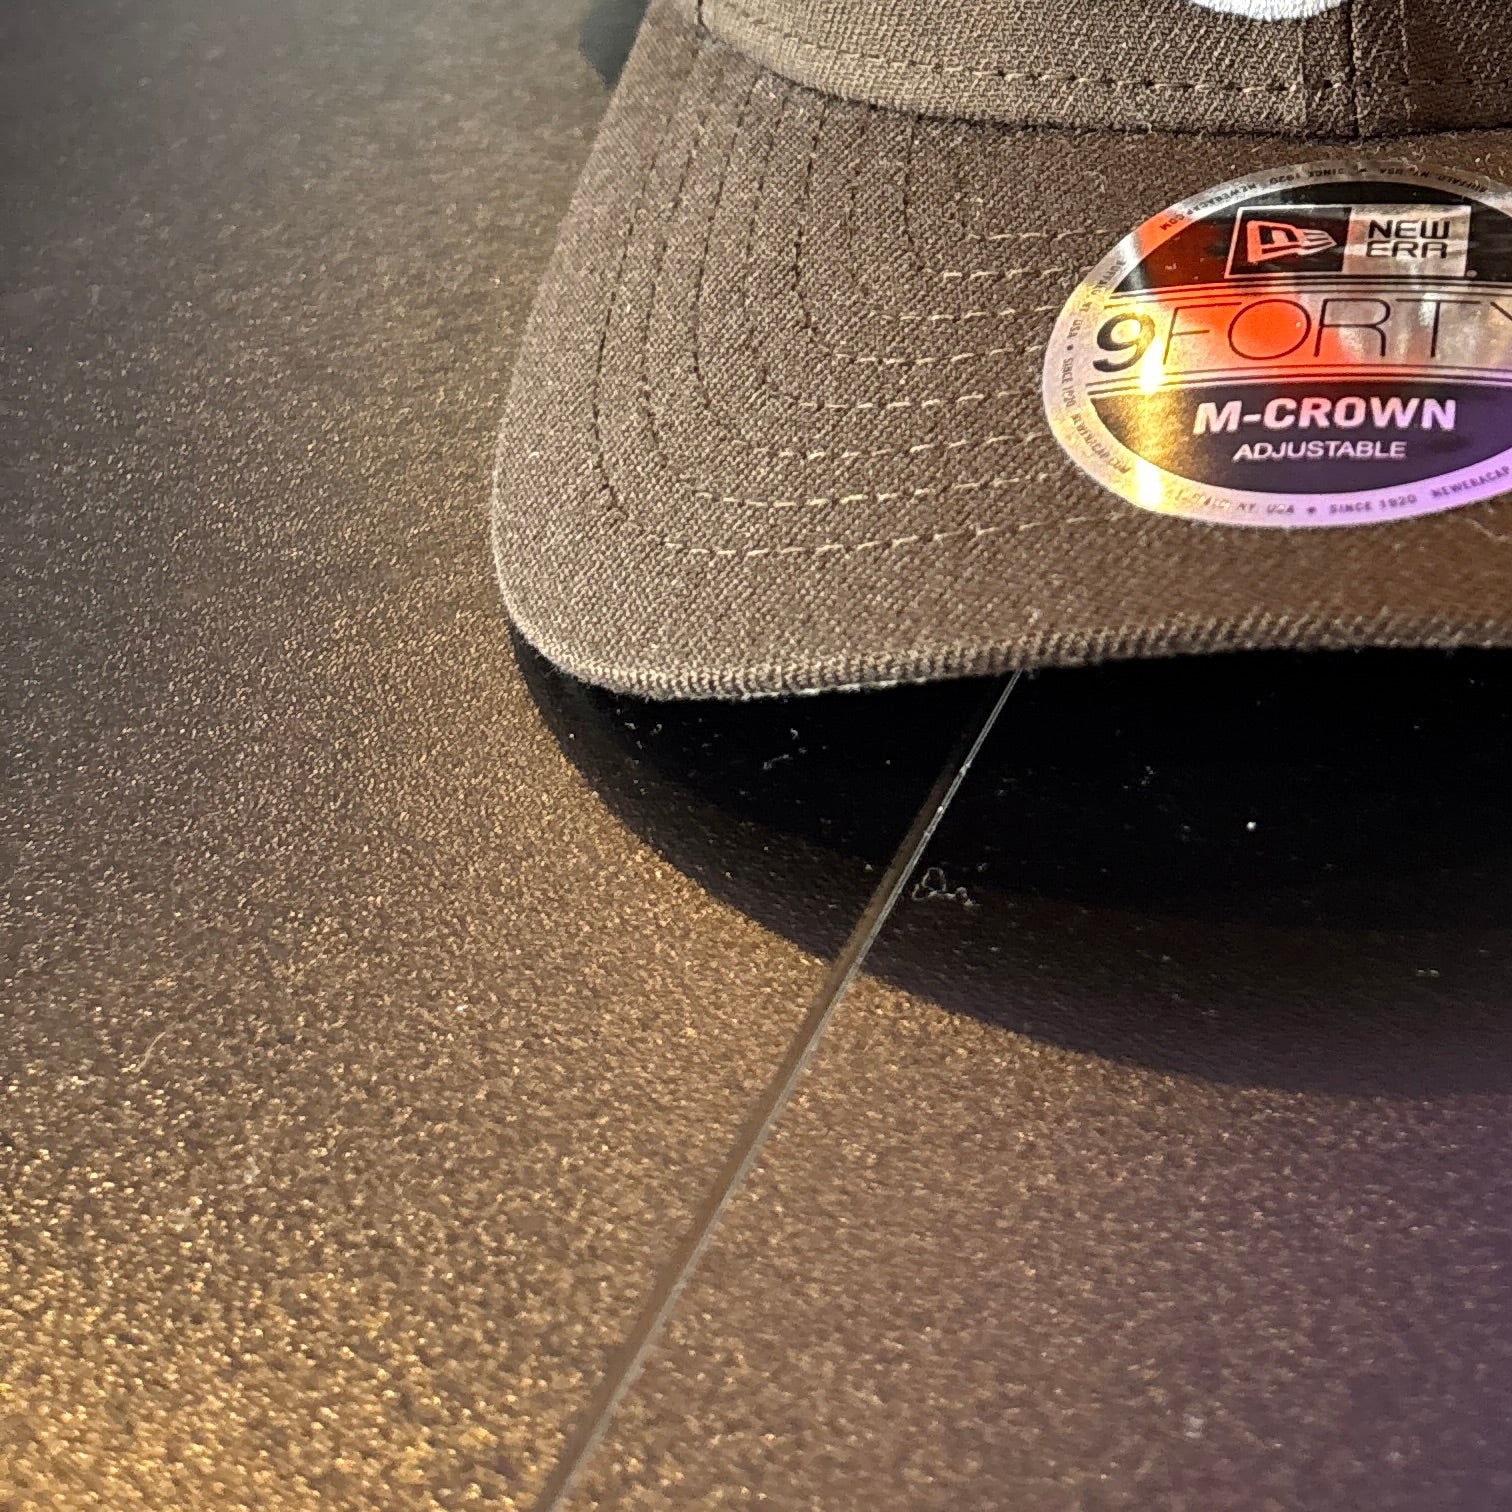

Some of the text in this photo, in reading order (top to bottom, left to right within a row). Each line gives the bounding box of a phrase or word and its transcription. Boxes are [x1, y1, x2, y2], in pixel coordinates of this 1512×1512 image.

[1368, 219, 1450, 239] NEW
[1366, 240, 1448, 259] ERA
[1192, 395, 1458, 436] M-CROWN
[1232, 438, 1409, 463] ADJUSTABLE
[1329, 499, 1373, 515] SINCE
[1379, 493, 1418, 510] 1920
